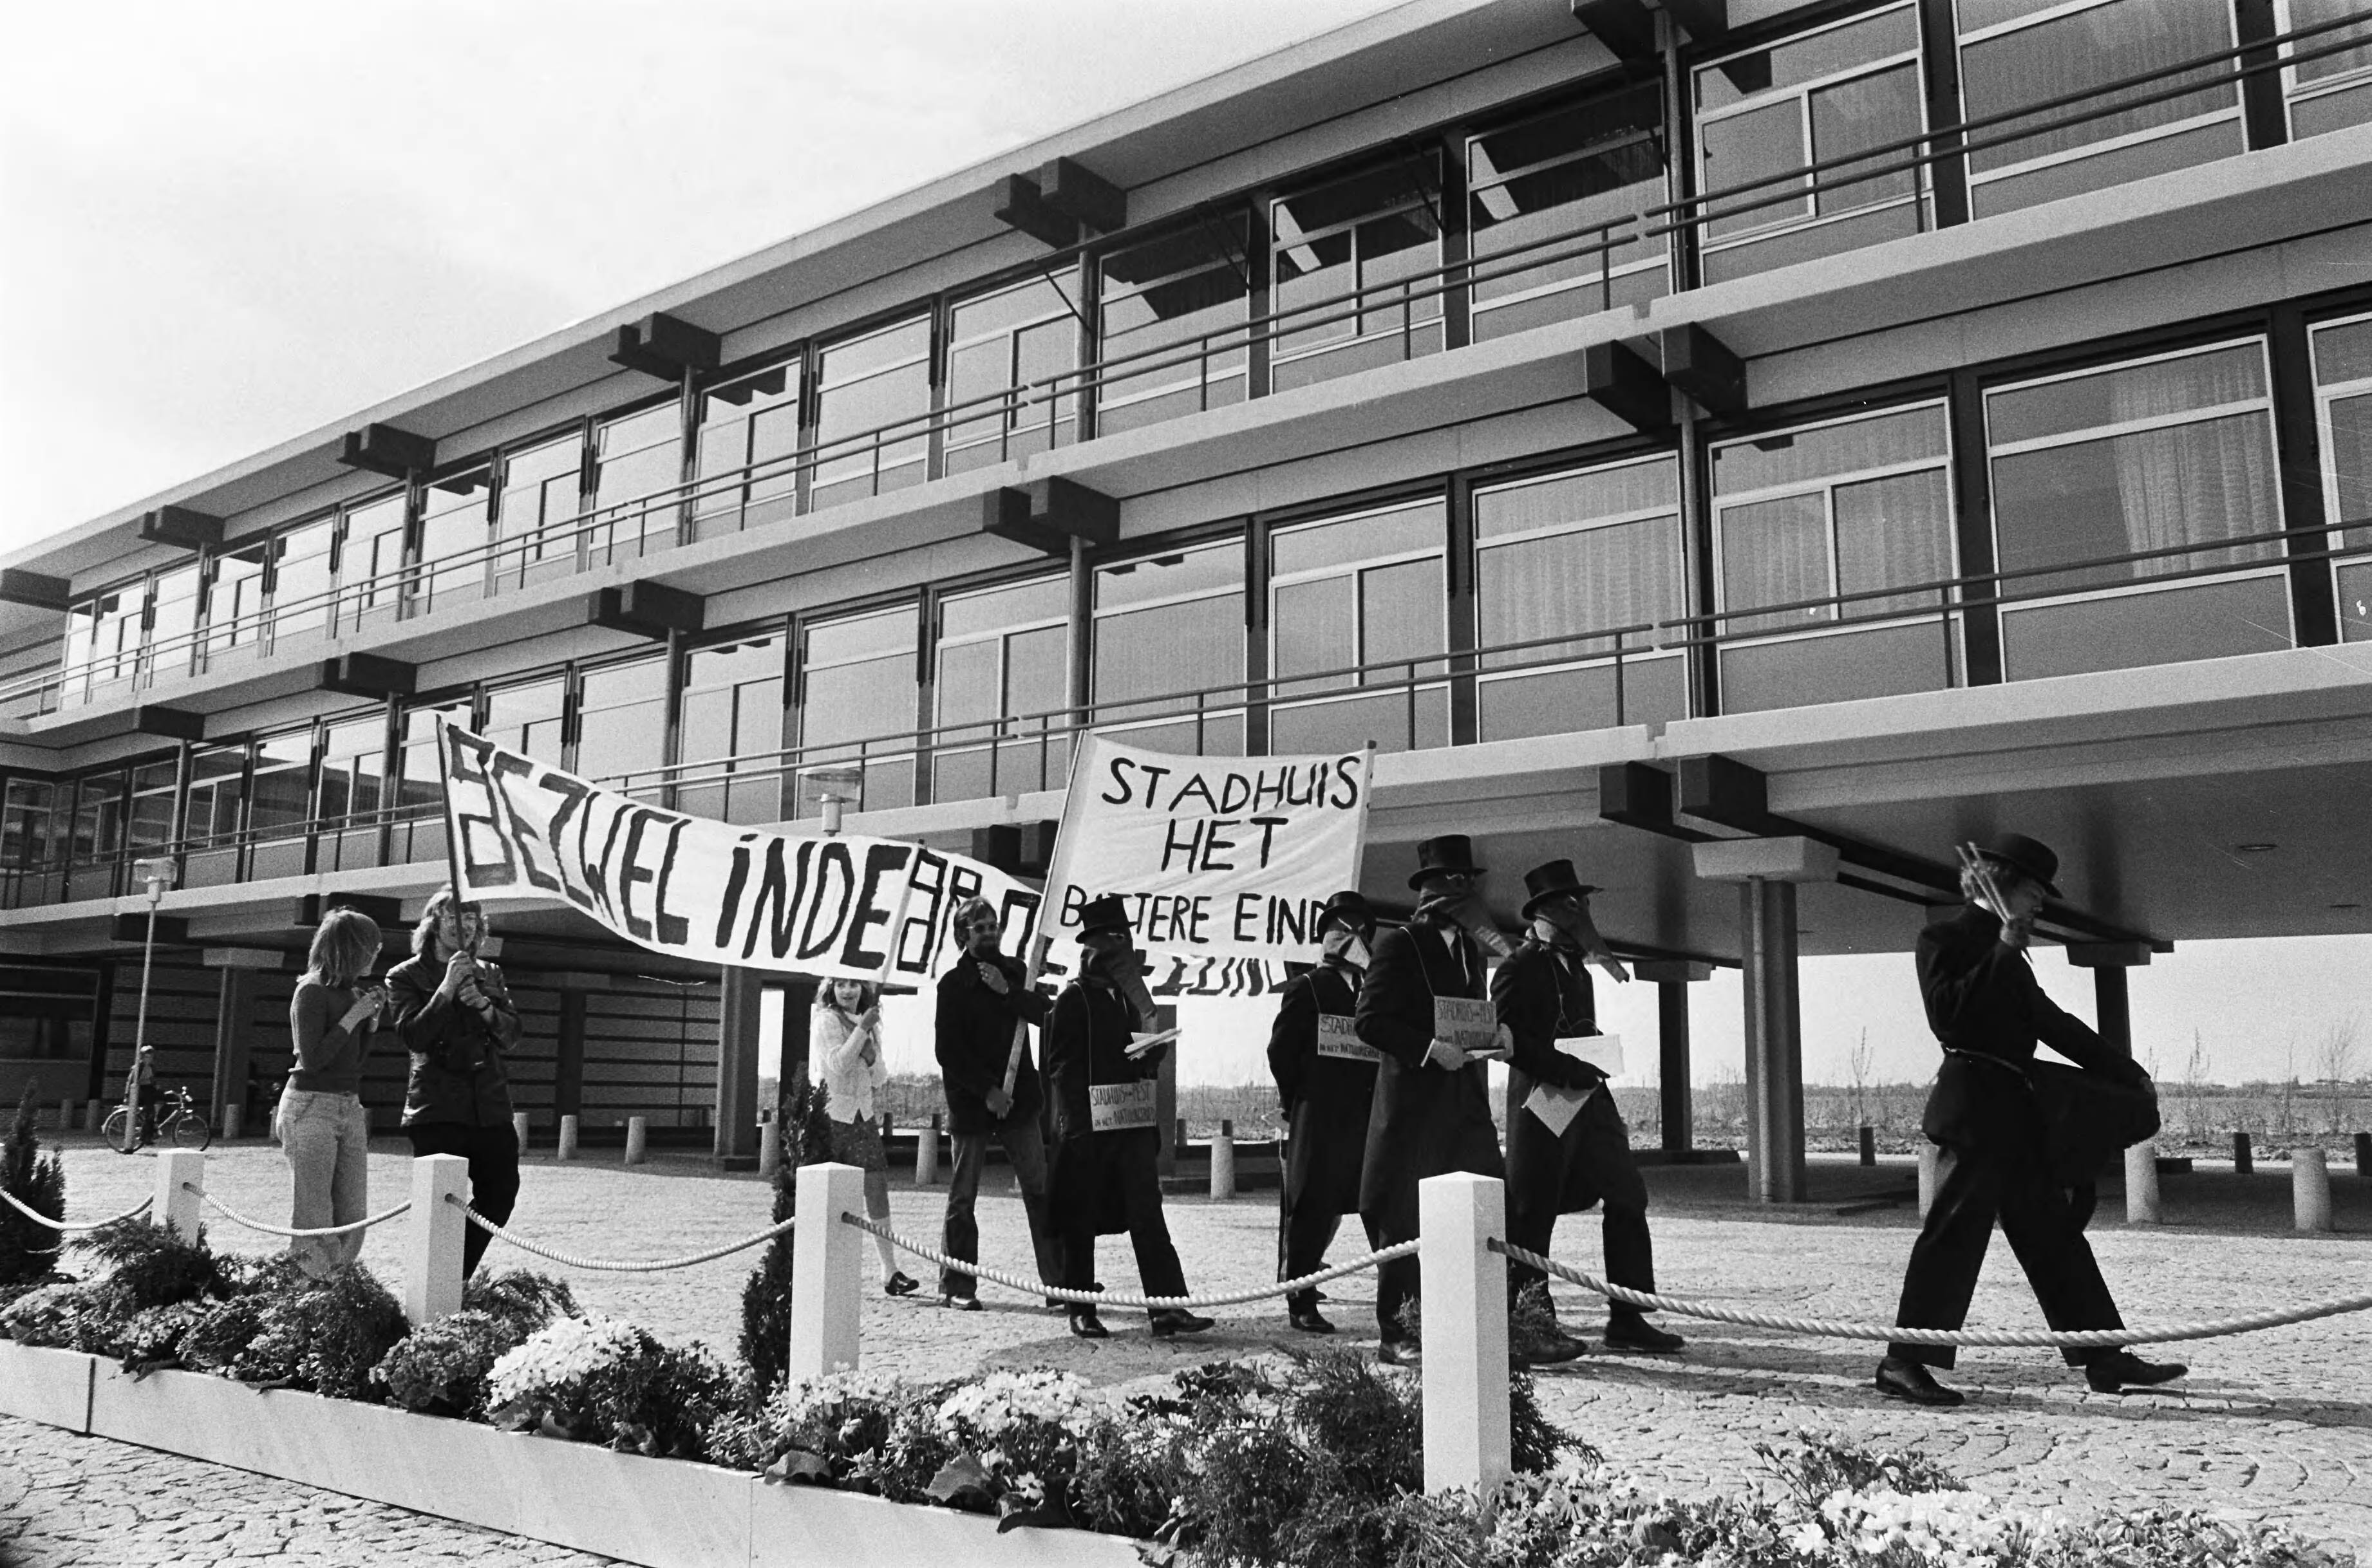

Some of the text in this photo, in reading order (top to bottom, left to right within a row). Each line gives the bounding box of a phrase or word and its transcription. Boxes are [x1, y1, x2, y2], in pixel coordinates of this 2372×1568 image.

[1102, 756, 1360, 814] STADHUIS
[1161, 817, 1288, 873] HET
[1060, 884, 1212, 944] BTERE
